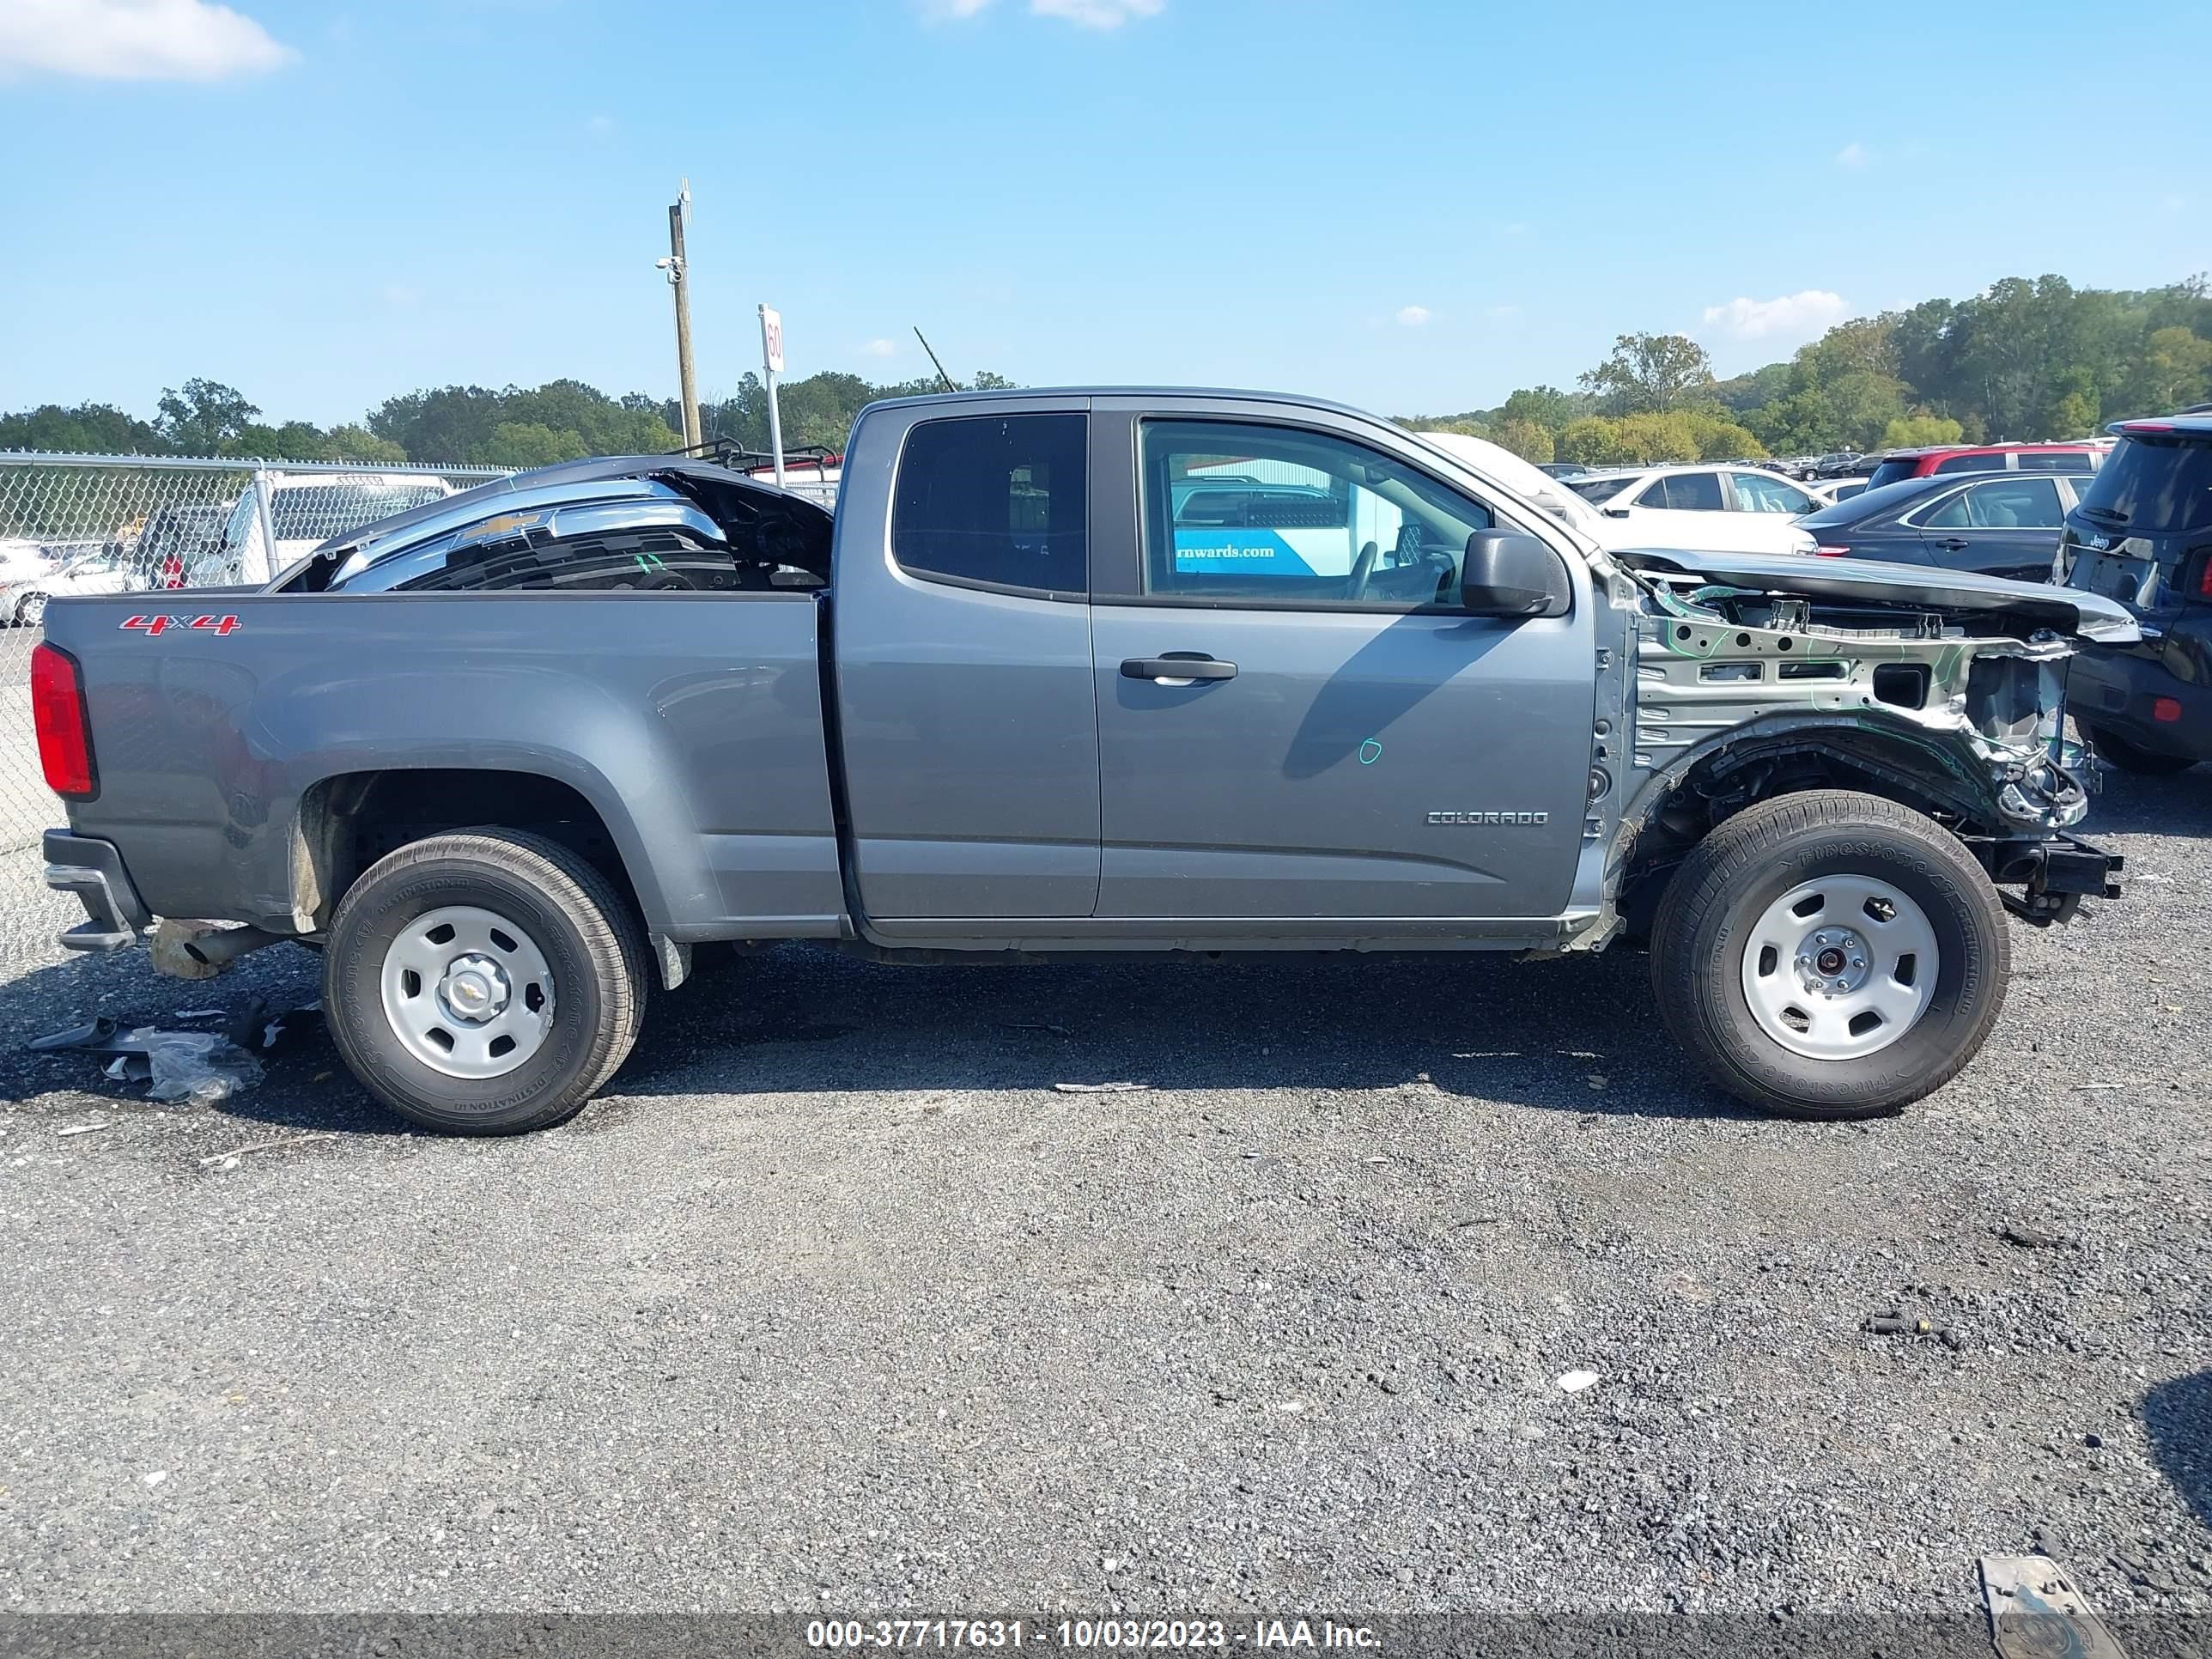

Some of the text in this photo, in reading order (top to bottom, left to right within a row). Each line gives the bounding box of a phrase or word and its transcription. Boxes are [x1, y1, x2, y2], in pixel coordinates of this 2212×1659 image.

[769, 323, 781, 358] 60
[2090, 534, 2109, 550] Jeep
[1427, 811, 1548, 824] COLORADO
[1797, 842, 1927, 873] Firestone
[1764, 1064, 1893, 1095] Firestone
